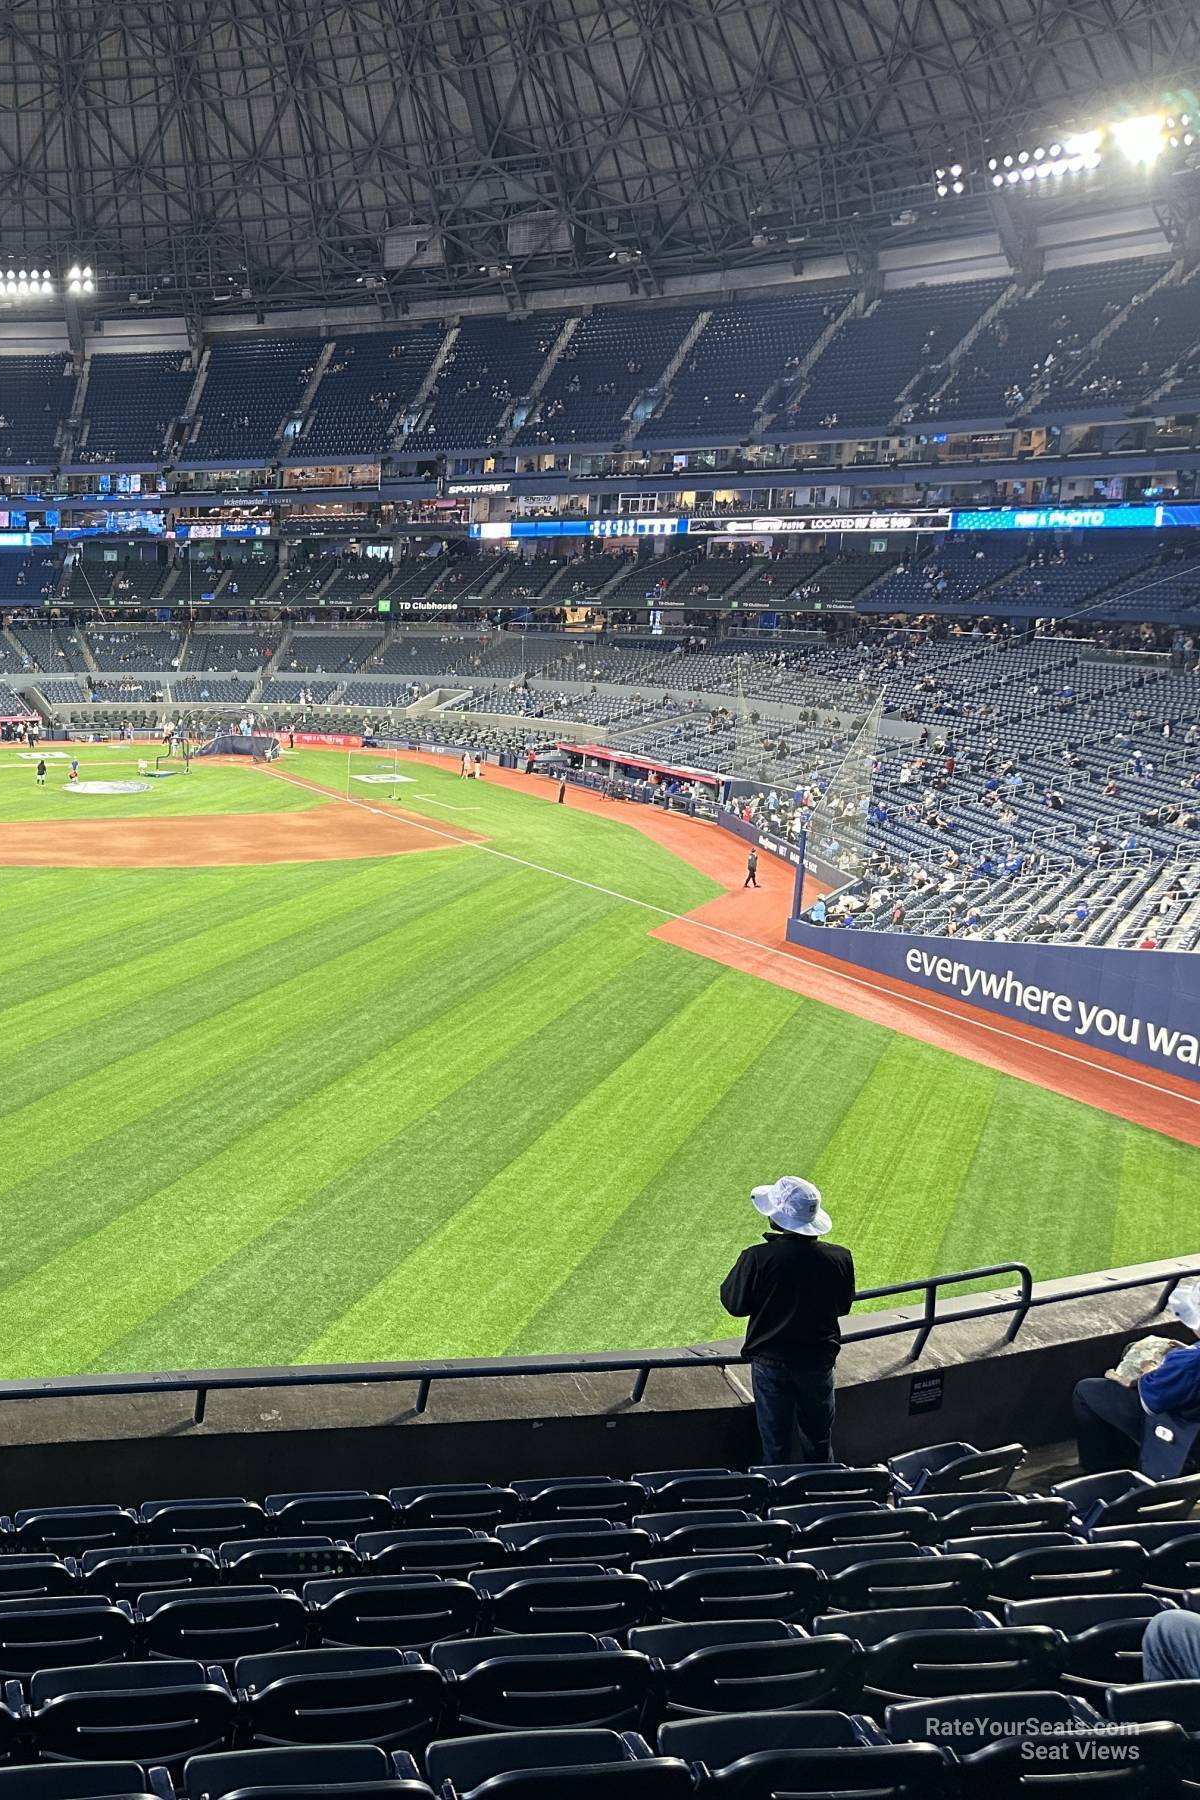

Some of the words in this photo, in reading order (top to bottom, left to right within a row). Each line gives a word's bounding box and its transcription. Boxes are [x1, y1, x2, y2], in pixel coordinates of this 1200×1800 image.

[448, 483, 511, 494] SPORTSNET
[223, 498, 265, 506] ticketmaster
[811, 518, 855, 529] LOCATED
[1049, 511, 1104, 526] PHOTO
[871, 541, 887, 553] TD
[399, 602, 411, 610] TD
[412, 602, 458, 610] Clubhouse
[906, 948, 1072, 1022] everywhere
[1075, 1001, 1140, 1045] you
[1146, 1022, 1200, 1067] wa
